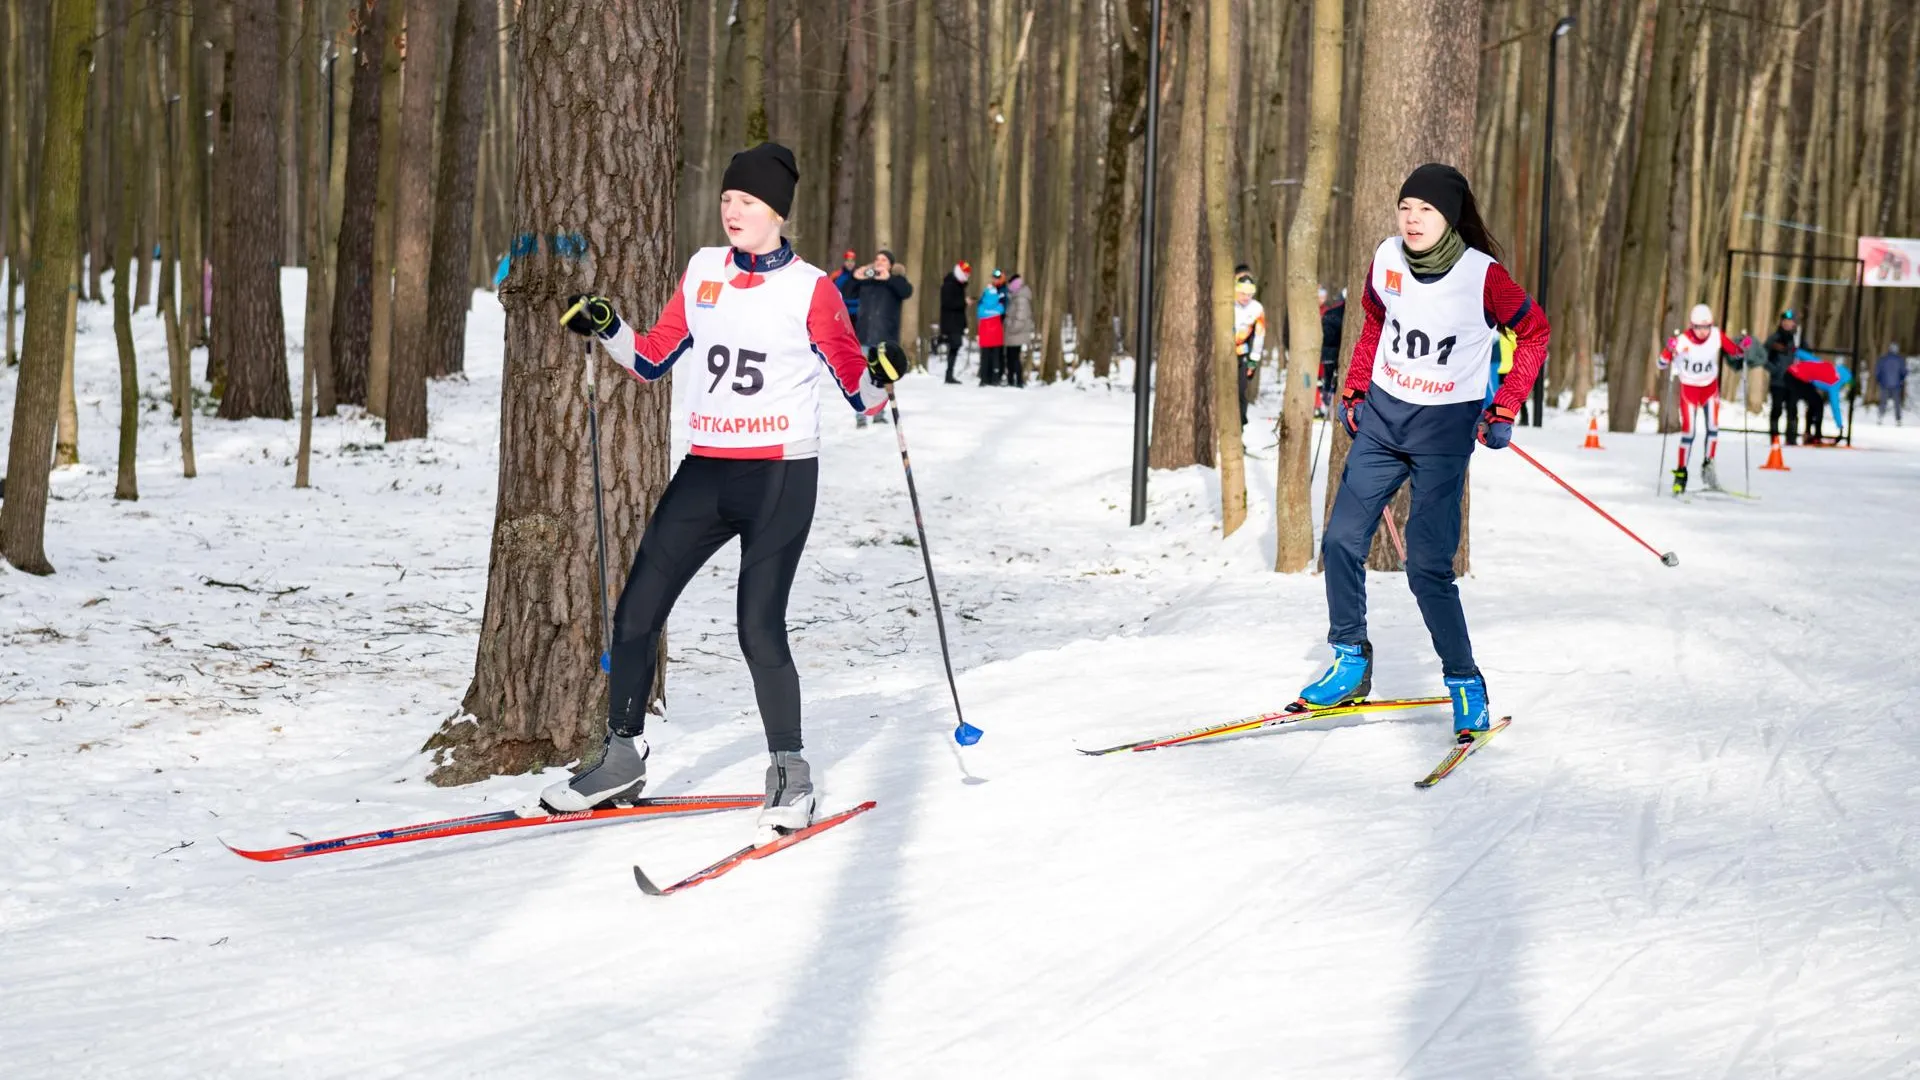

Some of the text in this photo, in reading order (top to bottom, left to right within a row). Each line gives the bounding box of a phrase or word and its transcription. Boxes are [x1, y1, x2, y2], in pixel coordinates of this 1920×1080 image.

[1392, 318, 1457, 366] 101
[707, 344, 767, 396] 95
[545, 810, 594, 823] MADSHUS
